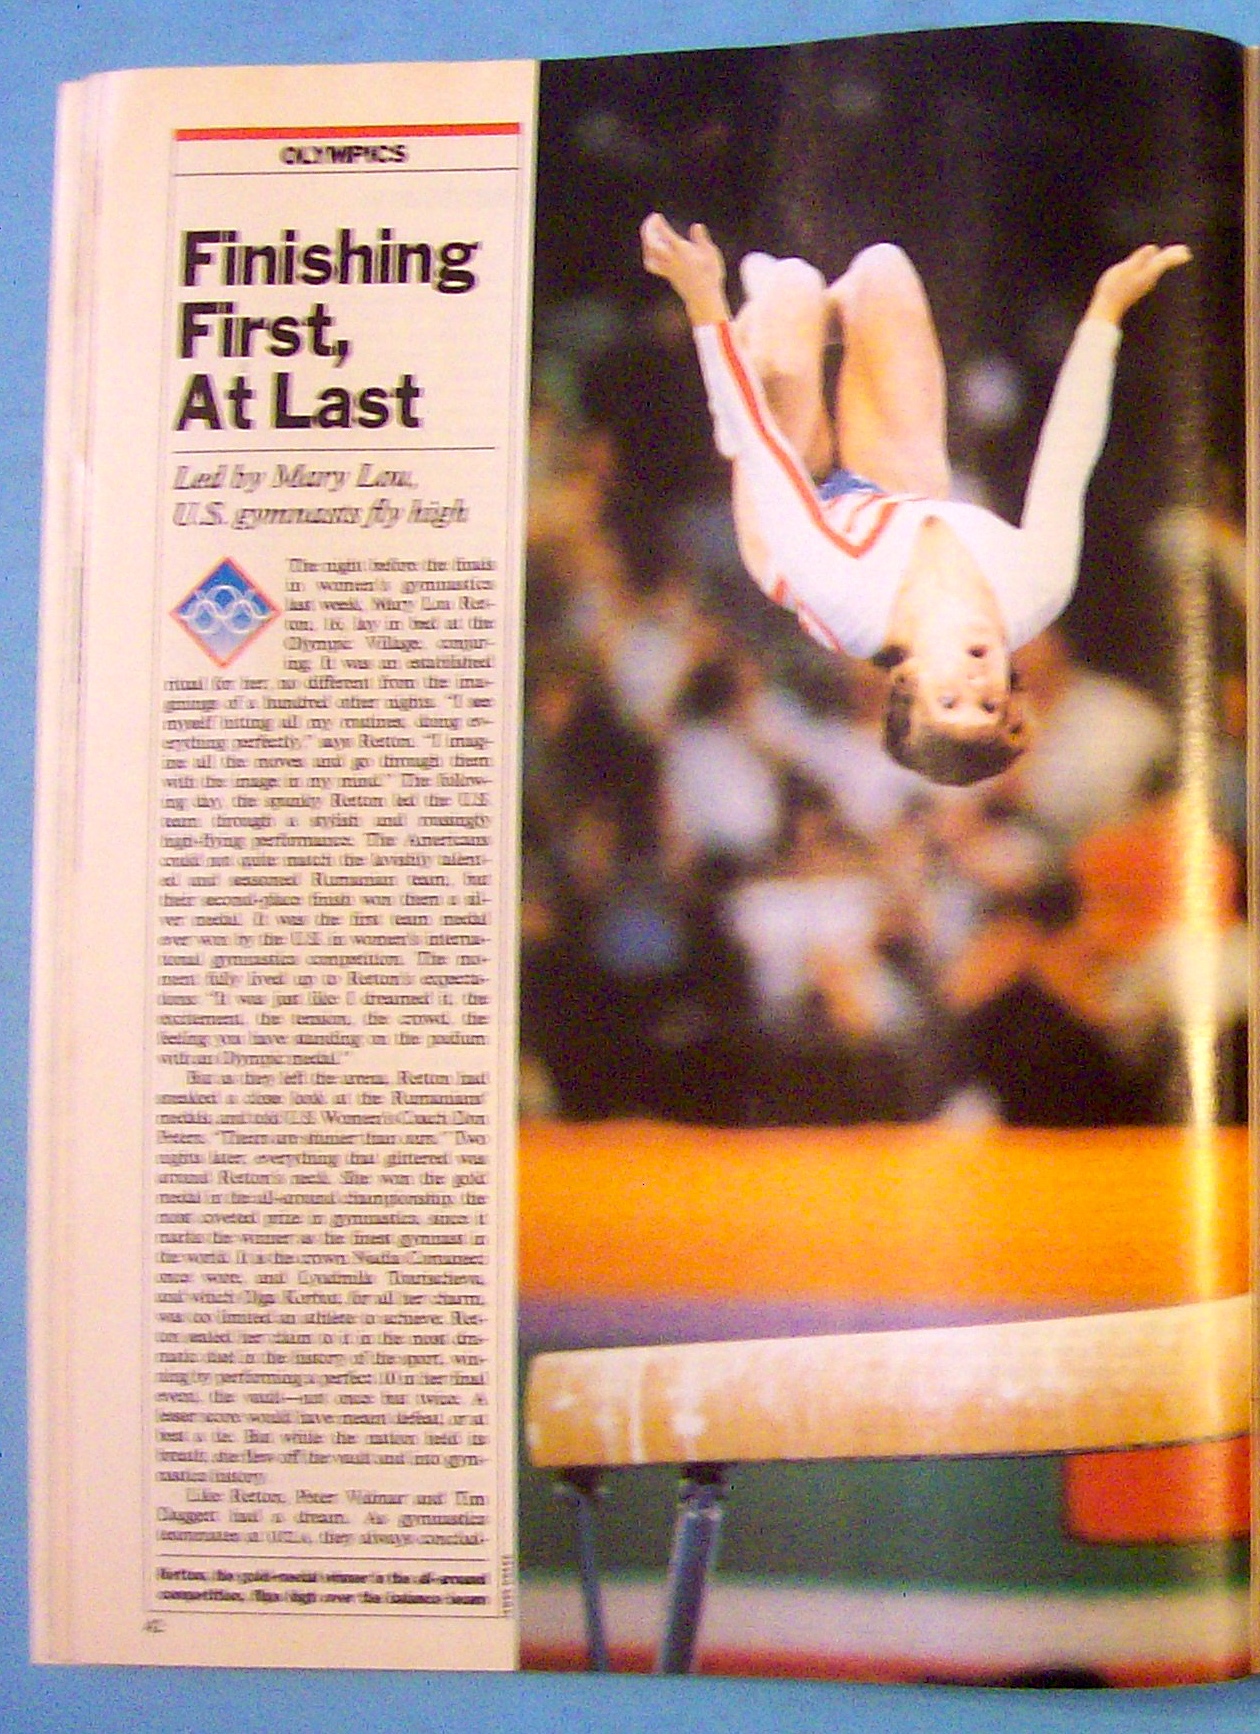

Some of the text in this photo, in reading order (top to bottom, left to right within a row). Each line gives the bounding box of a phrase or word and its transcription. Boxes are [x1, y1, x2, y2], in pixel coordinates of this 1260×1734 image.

[279, 144, 409, 165] OLYMPICS
[180, 227, 480, 294] Finishing
[176, 301, 353, 368] First,
[172, 371, 424, 431] At Last
[272, 463, 350, 492] Mary
